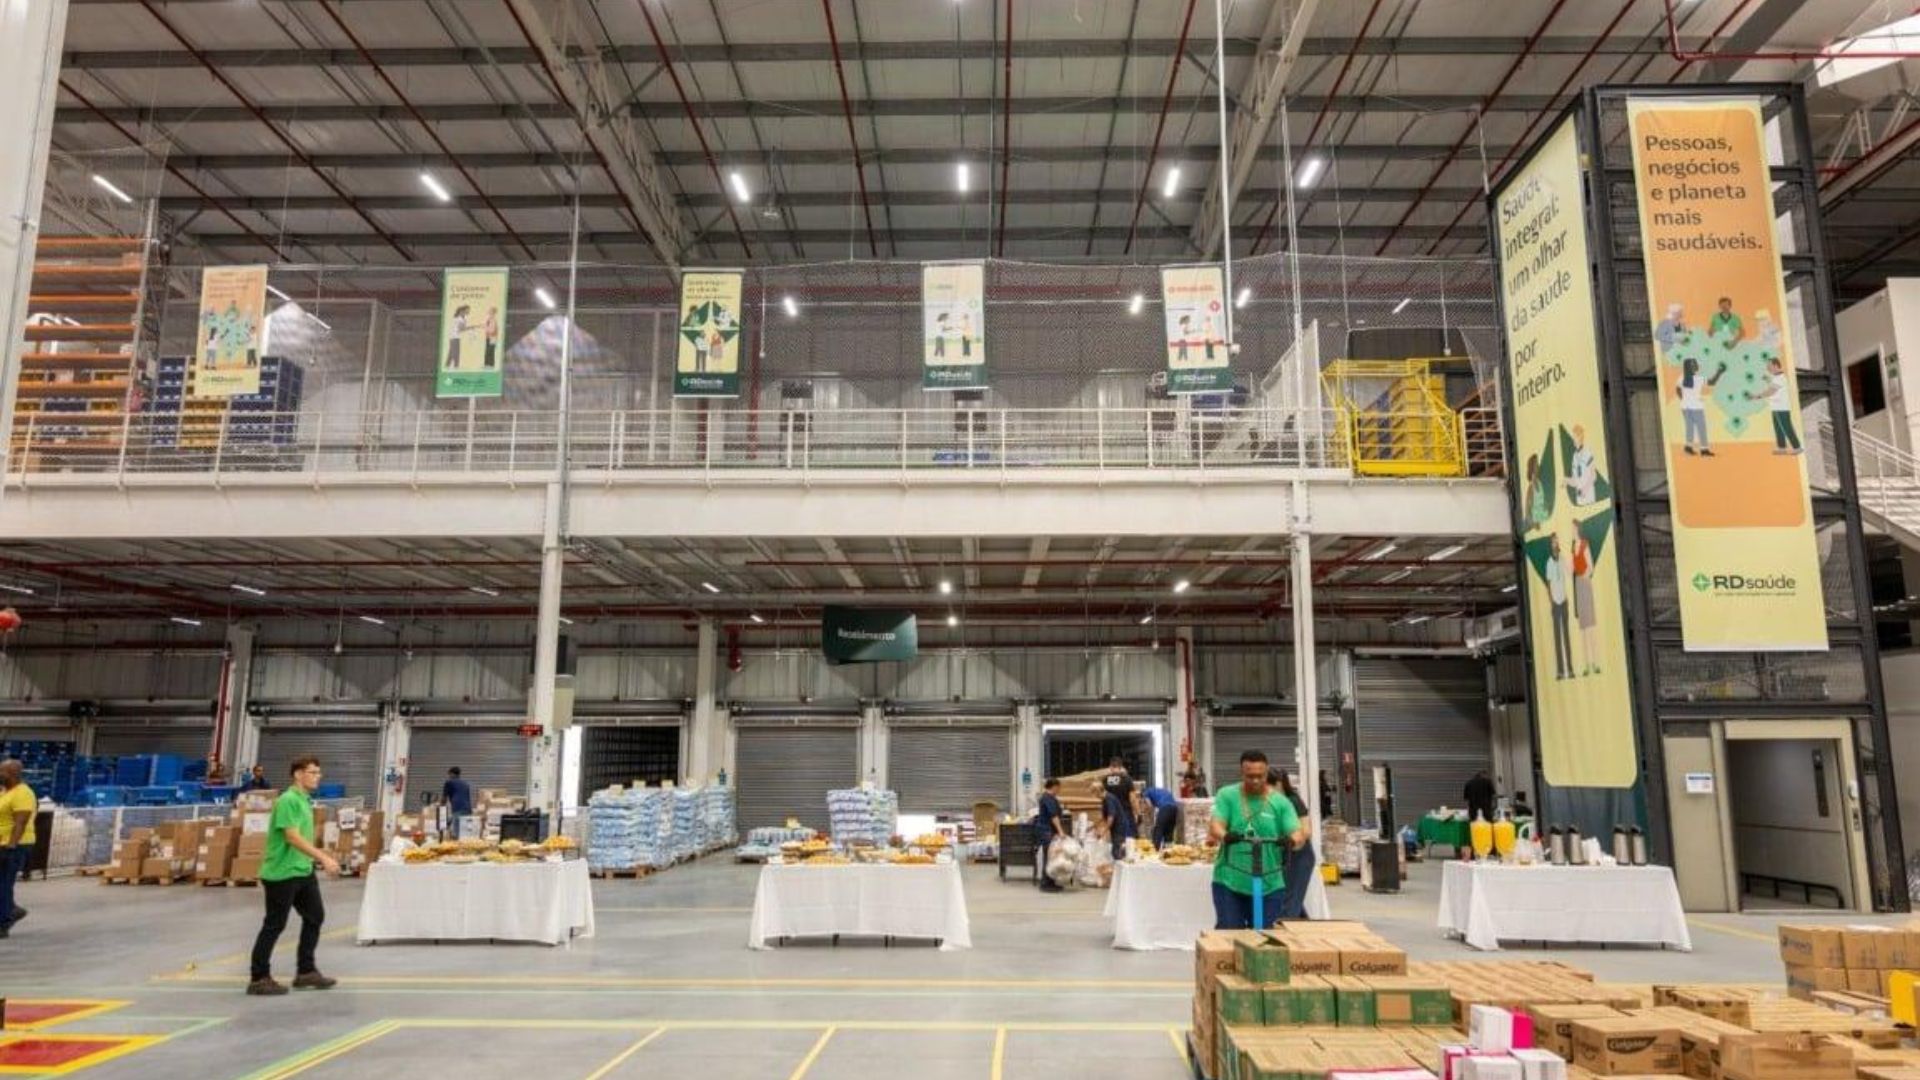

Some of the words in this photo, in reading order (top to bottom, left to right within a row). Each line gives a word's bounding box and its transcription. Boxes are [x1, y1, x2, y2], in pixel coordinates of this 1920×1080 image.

[1645, 135, 1733, 152] Pessoas,
[1648, 157, 1741, 179] negócios
[1650, 188, 1663, 201] e
[1669, 183, 1747, 204] planeta
[1505, 193, 1560, 261] integral:
[1654, 208, 1702, 226] mais
[1656, 232, 1764, 251] saudáveis.
[1508, 266, 1530, 297] um
[1532, 230, 1568, 275] olhar
[1511, 306, 1529, 333] da
[1515, 337, 1538, 377] por
[1517, 363, 1566, 408] inteiro.
[1713, 573, 1796, 589] RDsaúde
[1290, 962, 1332, 974] olgate
[1350, 961, 1400, 973] Colgate
